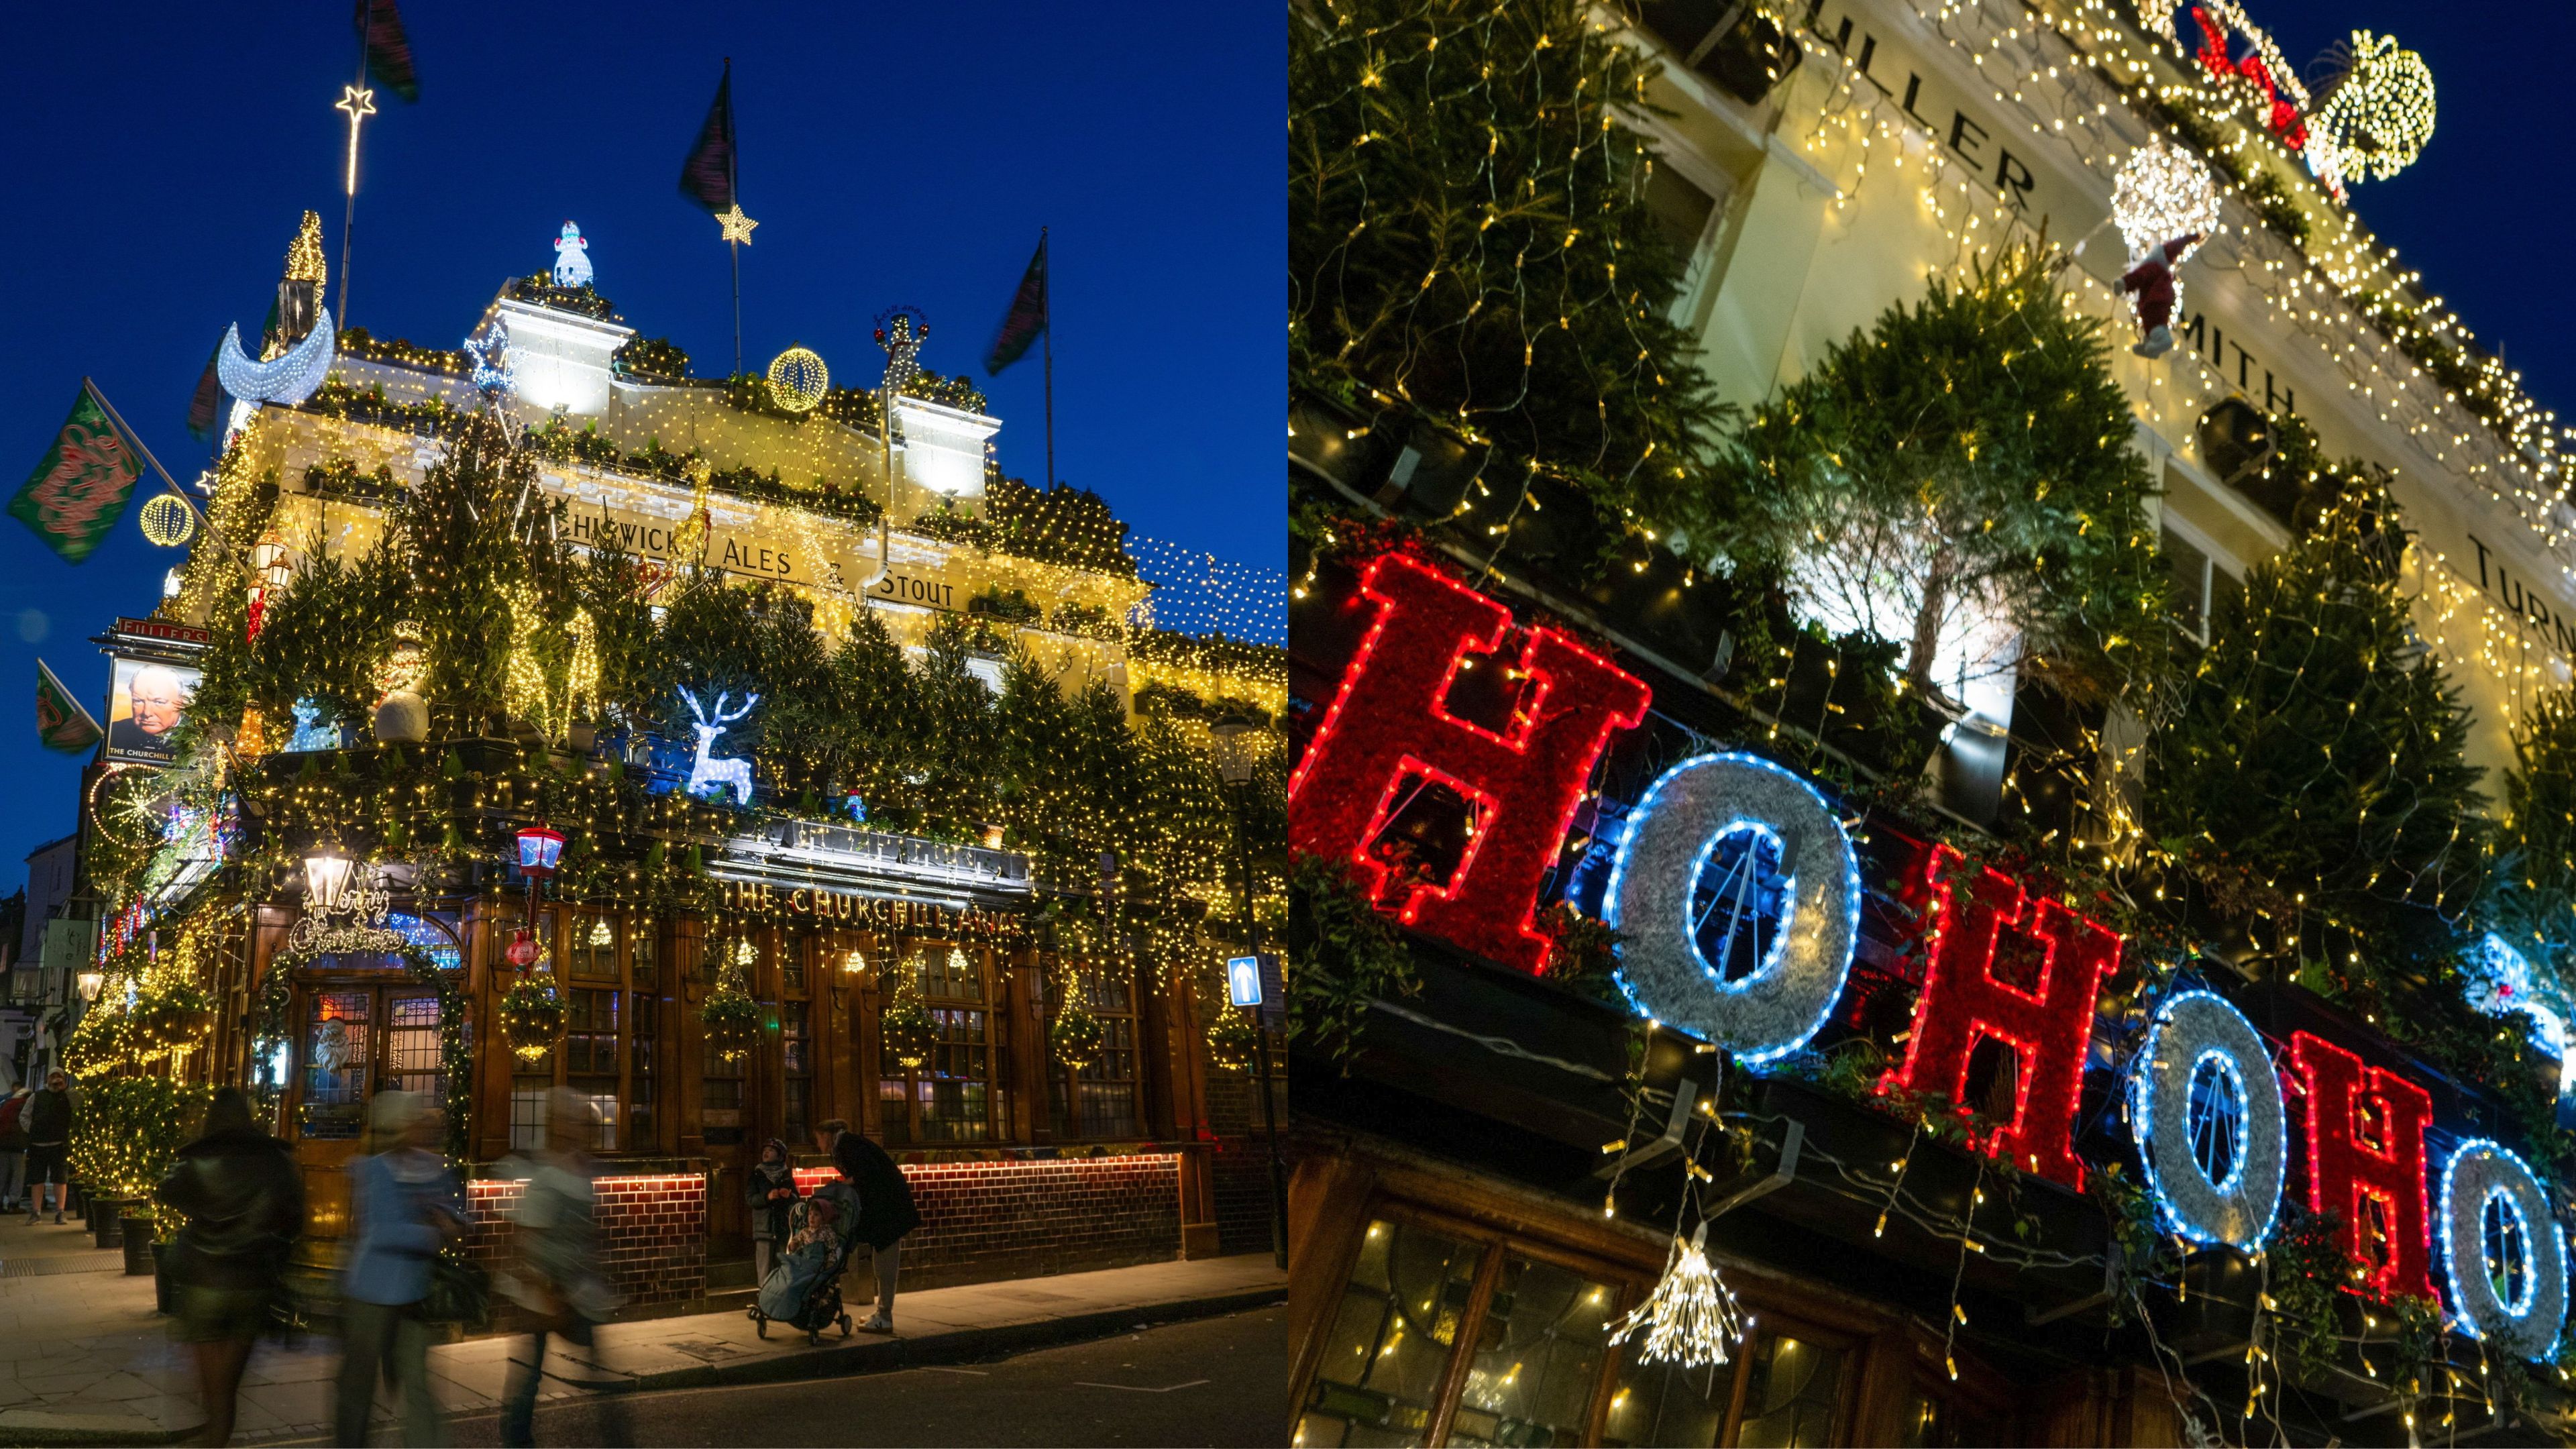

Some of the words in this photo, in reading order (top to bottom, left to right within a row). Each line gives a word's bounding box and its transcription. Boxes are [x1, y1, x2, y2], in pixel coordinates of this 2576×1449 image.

[2178, 307, 2294, 413] MITH
[565, 513, 681, 555] HIWICK
[722, 538, 791, 575] ALES
[880, 570, 953, 606] STOUT
[127, 749, 170, 760] CHURCHILL
[719, 879, 773, 911] THE
[790, 888, 948, 928] CHURCHILL
[957, 908, 1021, 937] ARMS
